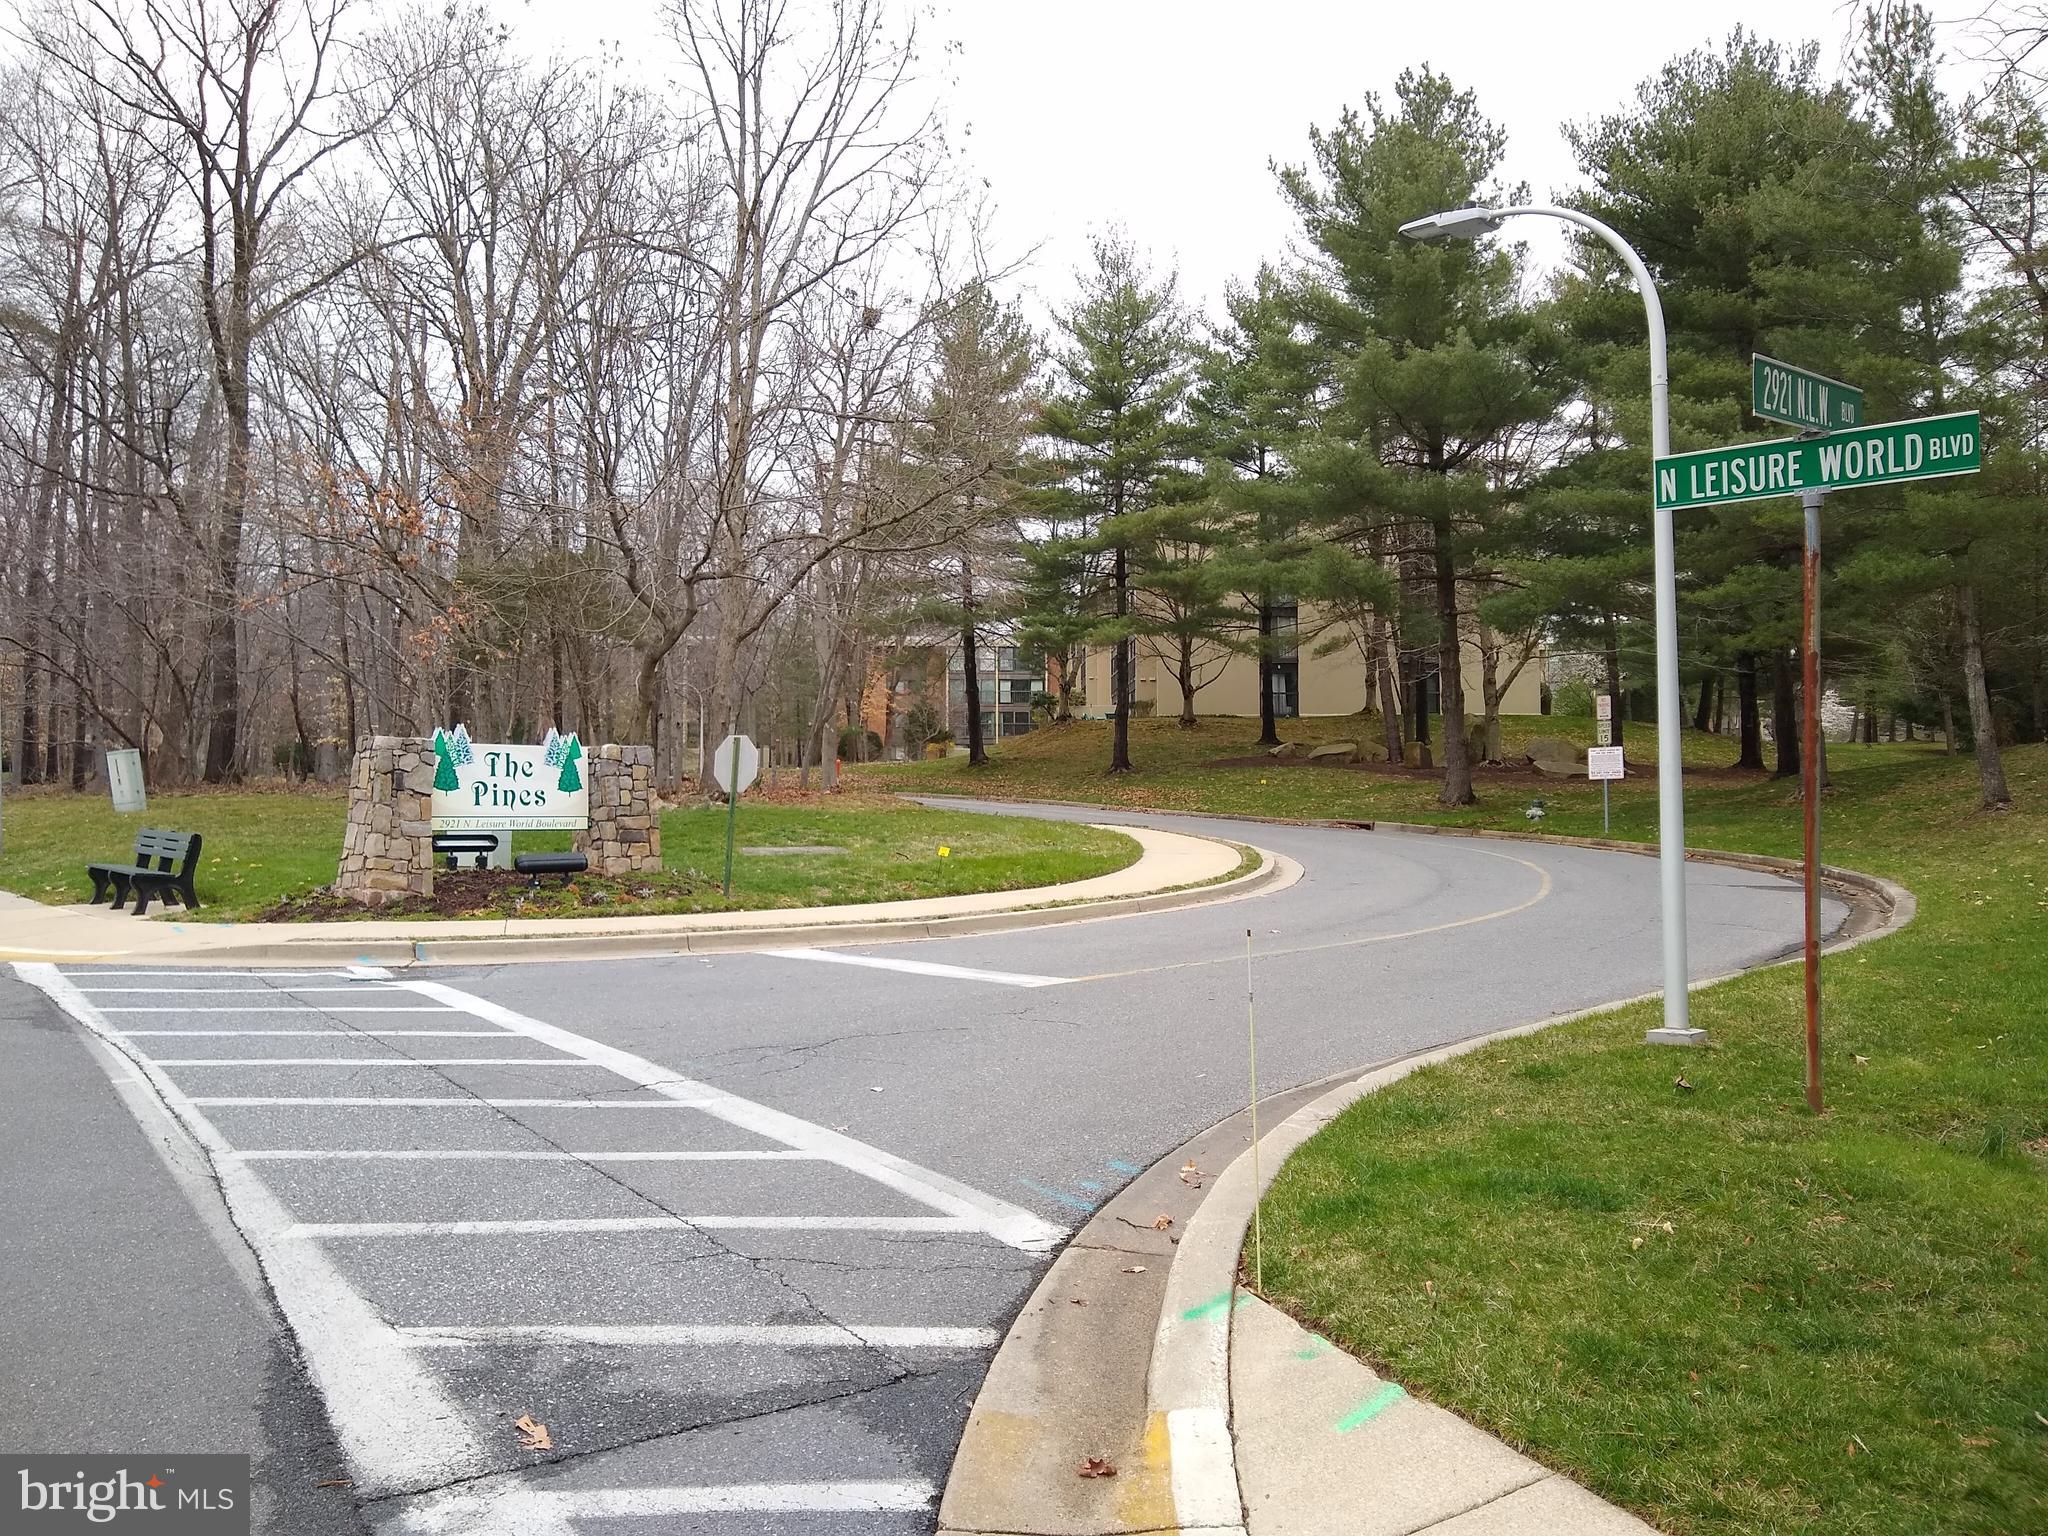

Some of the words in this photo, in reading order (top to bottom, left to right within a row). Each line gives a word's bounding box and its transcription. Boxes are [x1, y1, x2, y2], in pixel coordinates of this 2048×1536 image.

[1763, 366, 1792, 416] 2921
[1797, 377, 1832, 427] N.L.W.
[1841, 400, 1855, 424] BLVD
[1660, 468, 1677, 502] N
[1690, 449, 1803, 499] LEISURE
[1818, 432, 1923, 482] WORLD
[1929, 432, 1974, 461] BLVD
[1600, 734, 1609, 742] 15
[484, 752, 534, 783] The
[471, 780, 547, 812] Pines
[439, 819, 464, 829] 2921
[475, 819, 507, 829] Leisure
[509, 819, 534, 829] World
[536, 818, 577, 829] Boulevard
